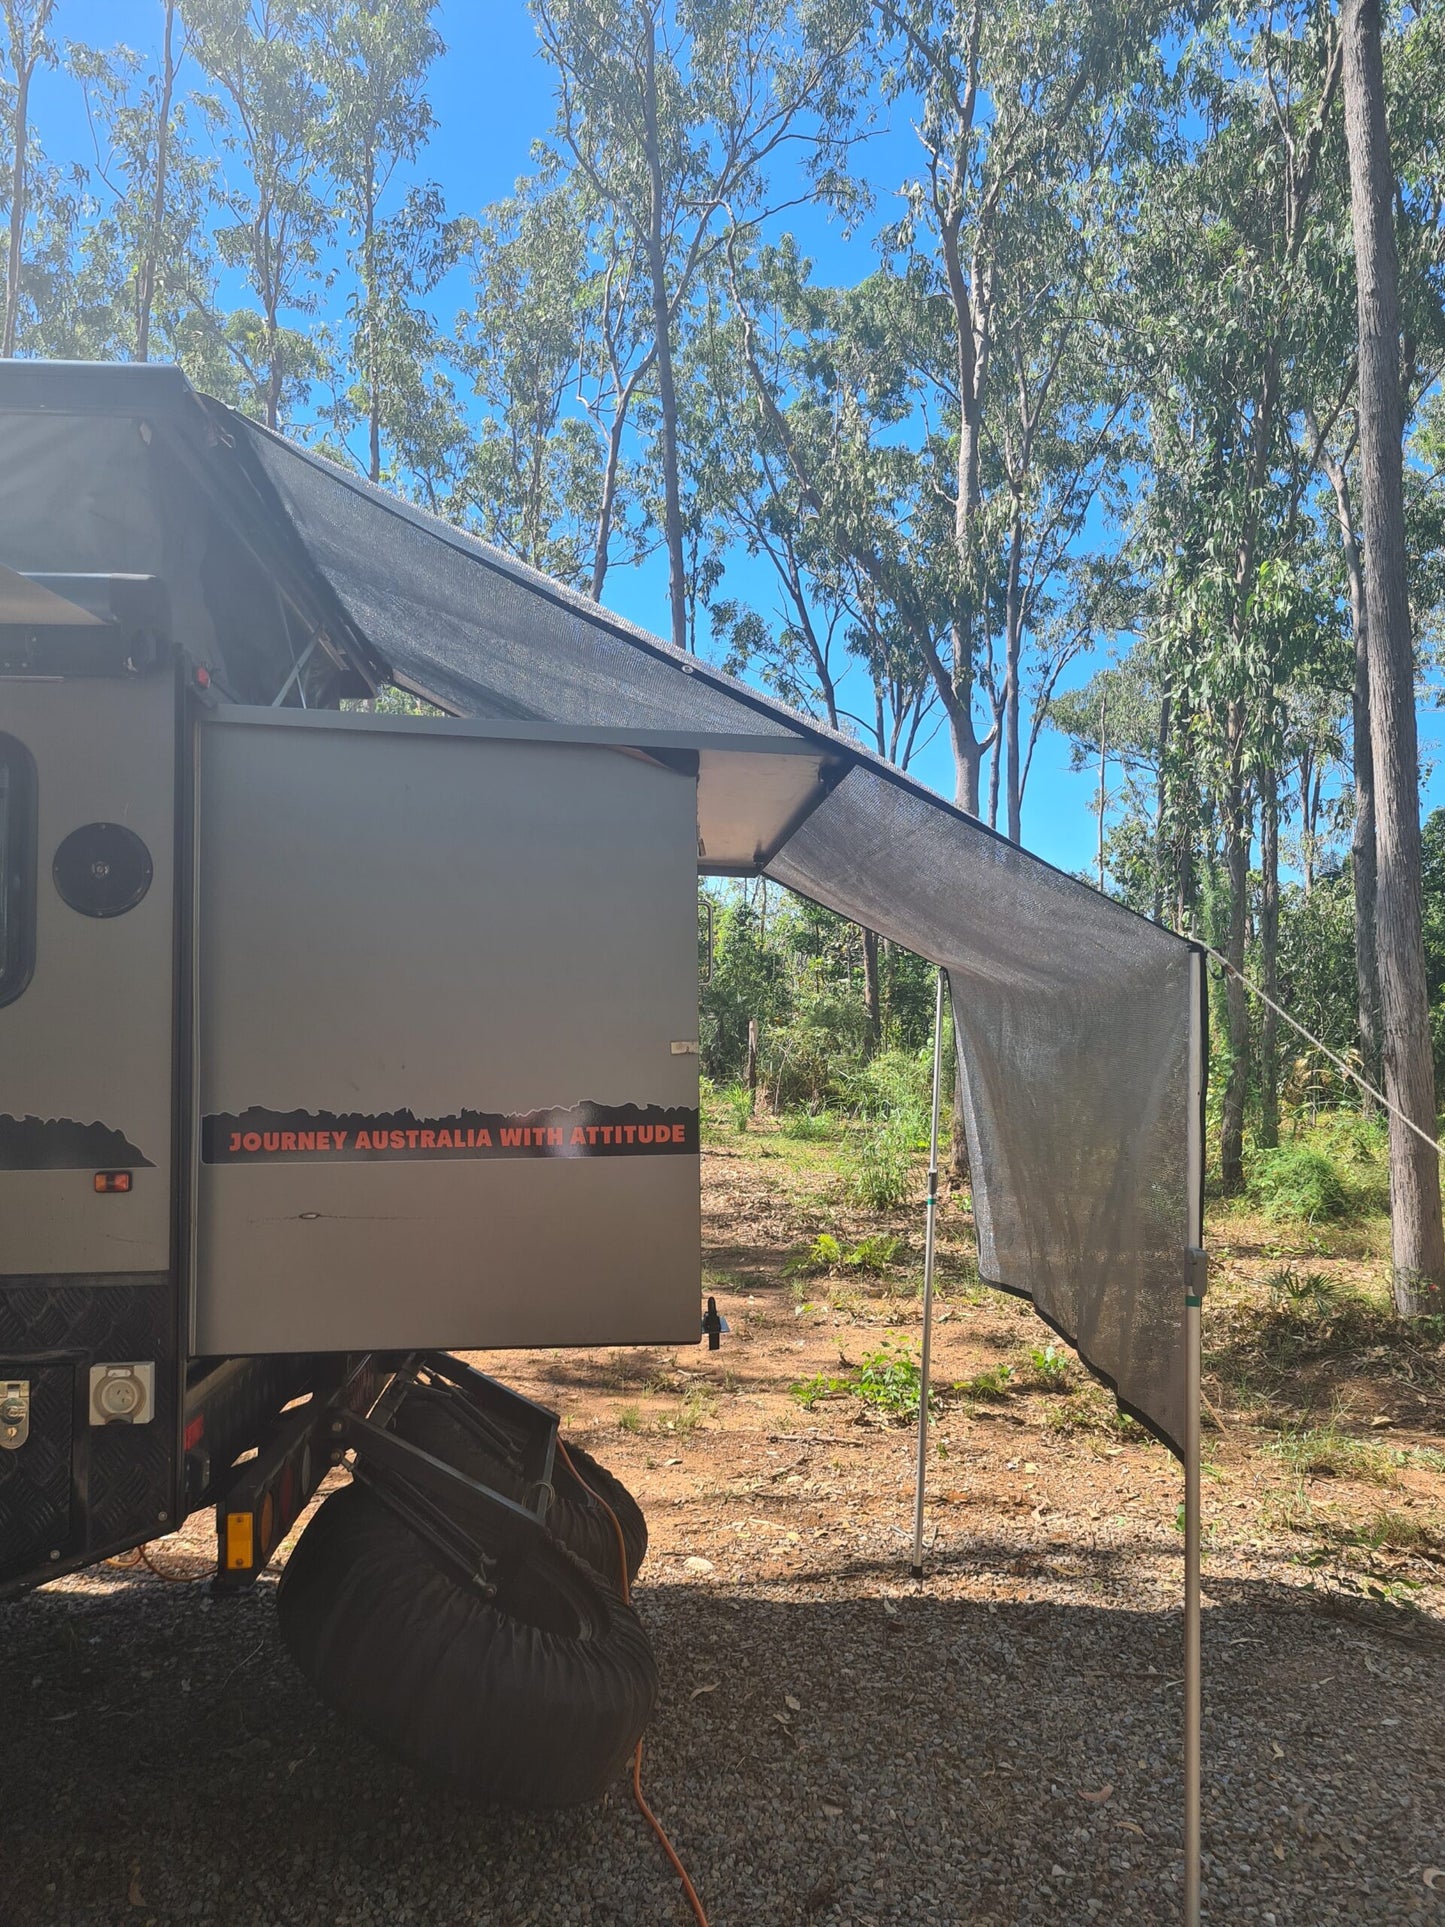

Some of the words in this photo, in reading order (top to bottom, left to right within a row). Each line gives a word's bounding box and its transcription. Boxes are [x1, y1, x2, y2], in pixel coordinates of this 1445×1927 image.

[229, 1131, 347, 1151] JOURNEY
[354, 1128, 492, 1149] AUSTRALIA
[499, 1126, 563, 1147] WITH
[569, 1124, 685, 1145] ATTITUDE
